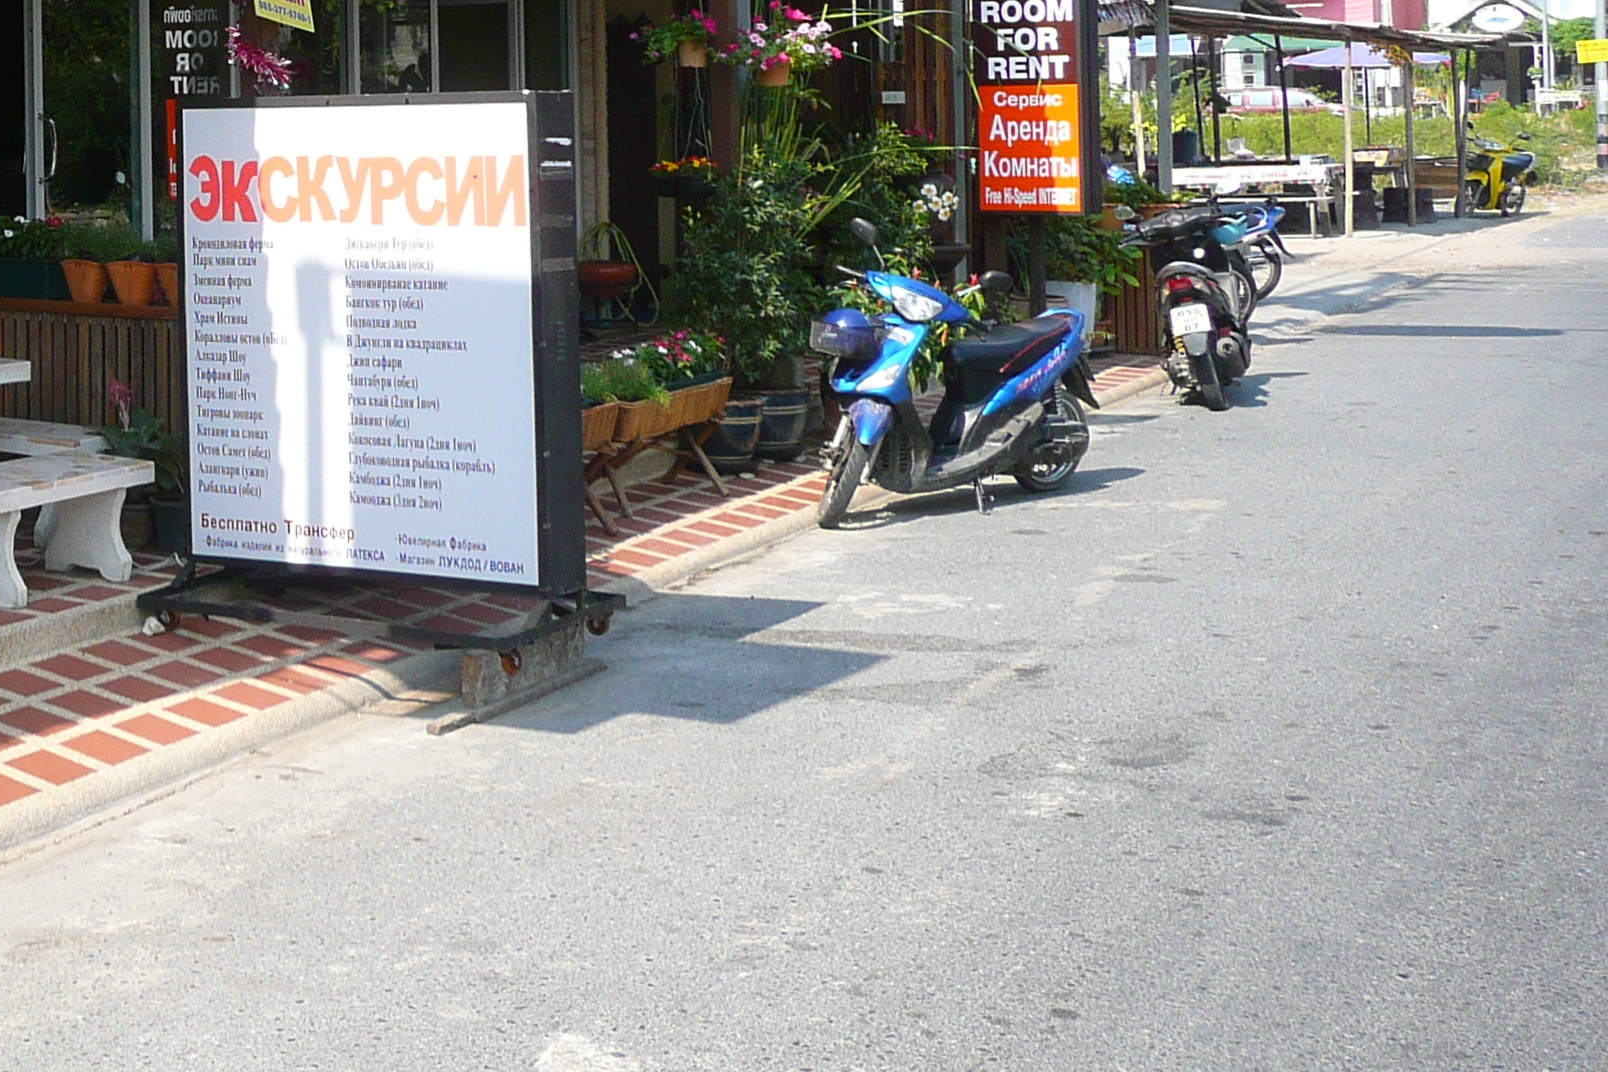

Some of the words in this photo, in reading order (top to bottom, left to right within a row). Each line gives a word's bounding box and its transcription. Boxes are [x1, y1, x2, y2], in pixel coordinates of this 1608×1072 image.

[997, 27, 1059, 51] FOR
[987, 55, 1070, 80] RENT
[993, 91, 1063, 110] Сервис
[989, 114, 1072, 147] Аренда
[984, 151, 1077, 177] Комнаты
[188, 154, 527, 228] ЭКСКУРСИИ
[985, 187, 1002, 204] Free
[1004, 187, 1037, 208] Hi-Speed
[193, 253, 213, 269] Парк
[227, 274, 252, 290] ферма
[194, 292, 241, 308] Океанариум
[346, 295, 380, 308] Бангкок
[383, 299, 397, 313] тур
[194, 311, 215, 327] Храм
[217, 311, 248, 324] Истины
[346, 315, 390, 328] Подводная
[392, 319, 417, 329] лодка
[346, 334, 352, 347] В
[354, 334, 391, 351] Джунгли
[393, 339, 403, 349] на
[229, 350, 246, 366] Шоу
[347, 354, 370, 367] Джип
[372, 354, 402, 372] сафари
[233, 369, 250, 385] Шоу
[348, 373, 392, 391] Чантабури
[196, 386, 217, 403] Парк
[348, 393, 366, 406] Река
[348, 412, 382, 427] Дайвинг
[231, 429, 240, 438] на
[241, 429, 268, 439] слонах
[348, 432, 391, 447] Кокосовая
[393, 434, 424, 451] Лагуна
[412, 456, 450, 471] рыбалка
[201, 513, 278, 534] Бесплатно
[284, 519, 355, 542] Трансфер
[449, 536, 487, 552] Фабрика
[490, 561, 524, 575] ВОВАН
